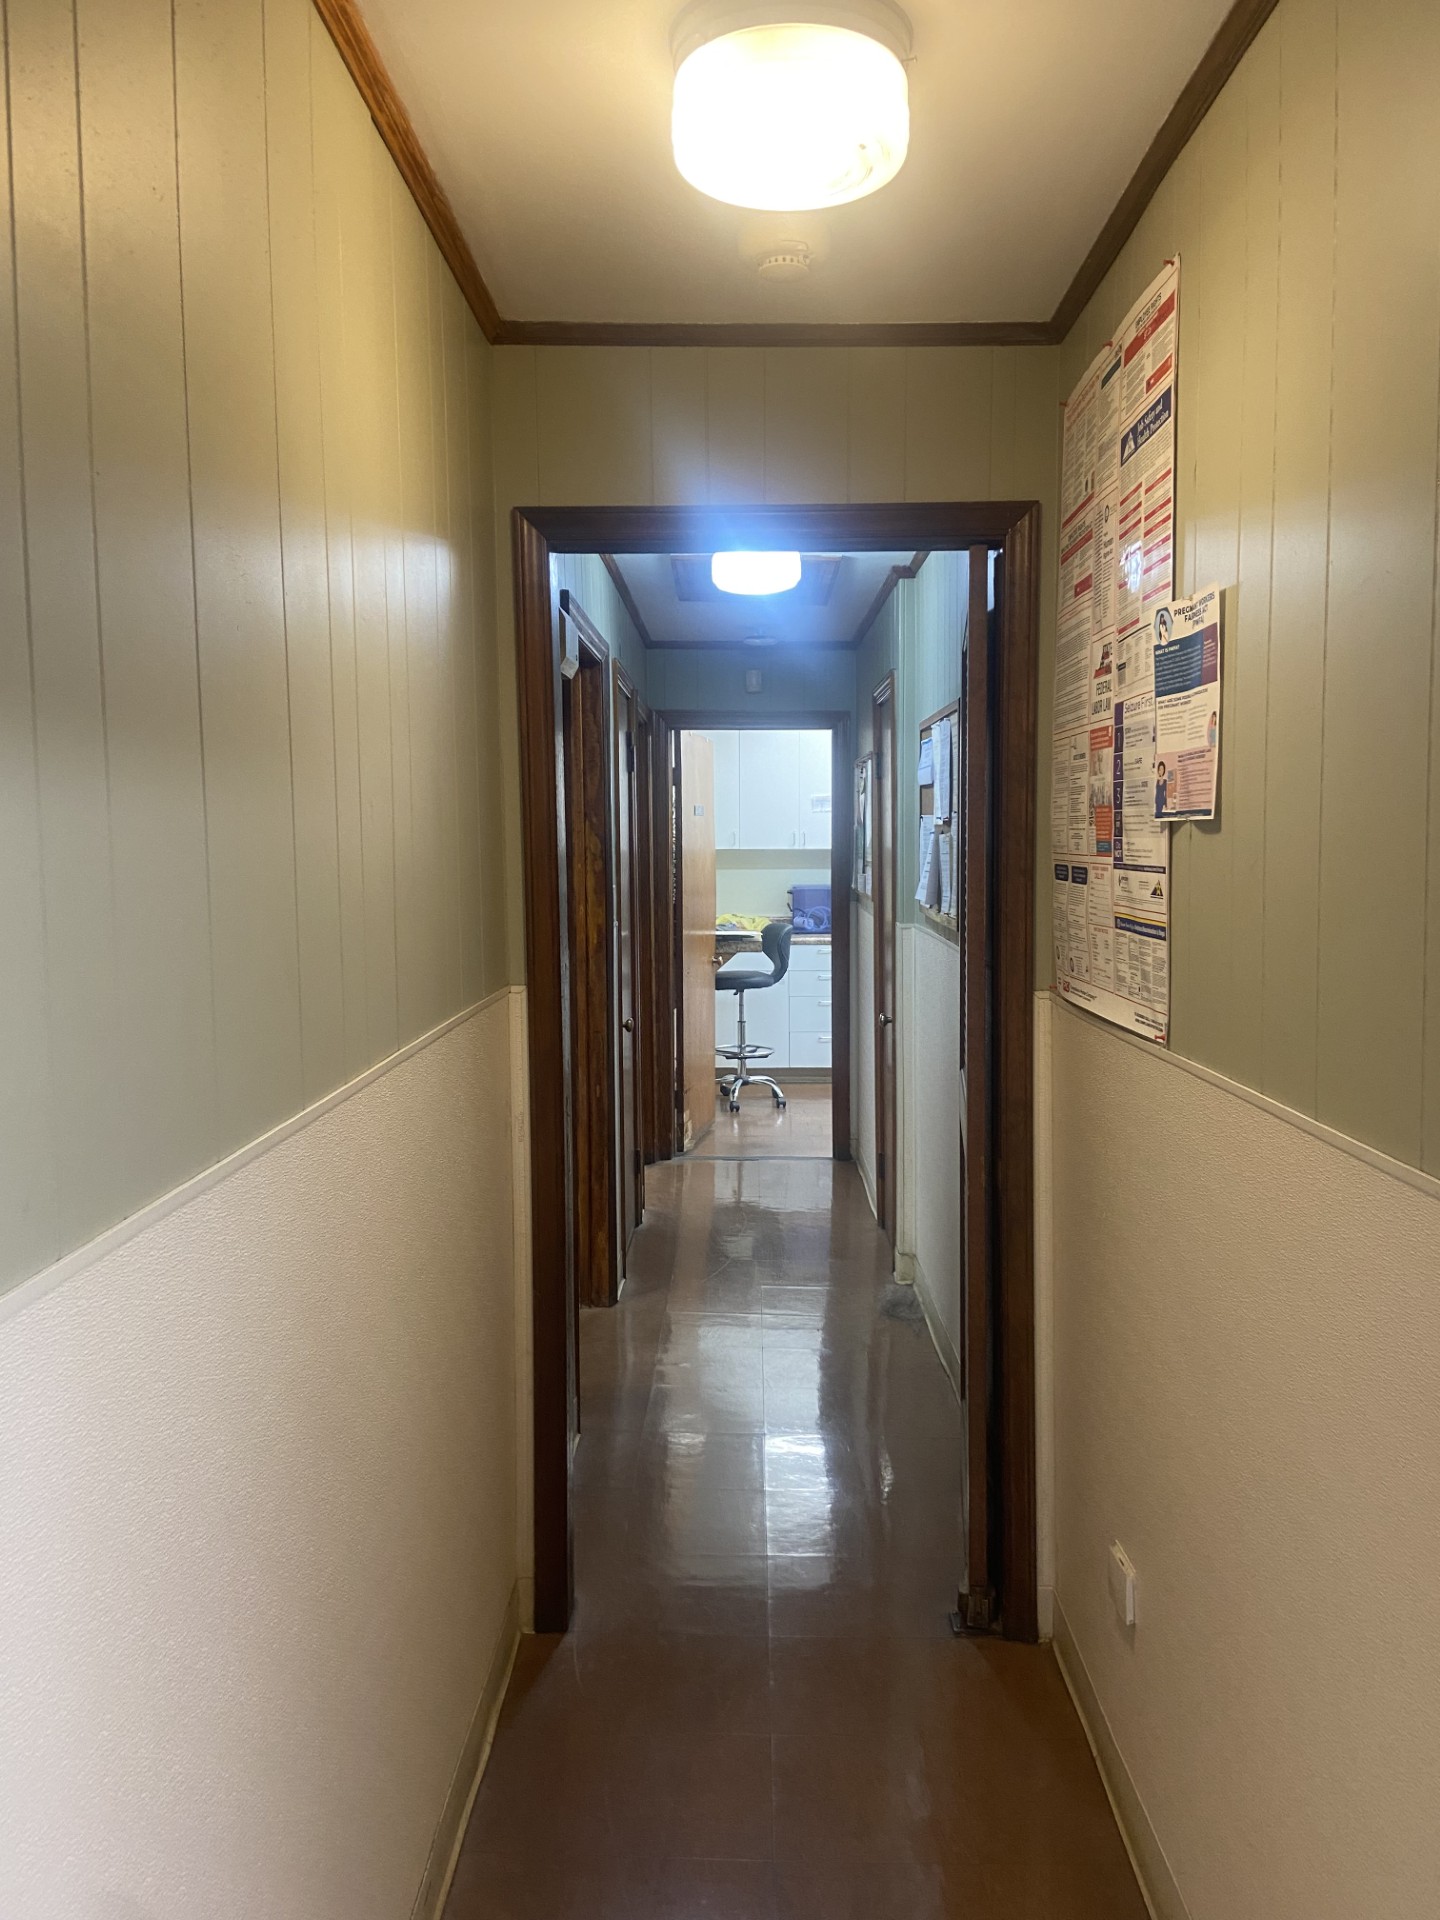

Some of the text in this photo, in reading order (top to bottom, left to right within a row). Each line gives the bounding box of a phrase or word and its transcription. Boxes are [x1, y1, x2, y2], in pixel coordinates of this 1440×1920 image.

[1174, 602, 1198, 617] PREGNANT
[1096, 679, 1112, 696] FEDERAL
[1116, 759, 1121, 775] 2
[1116, 788, 1121, 804] 3
